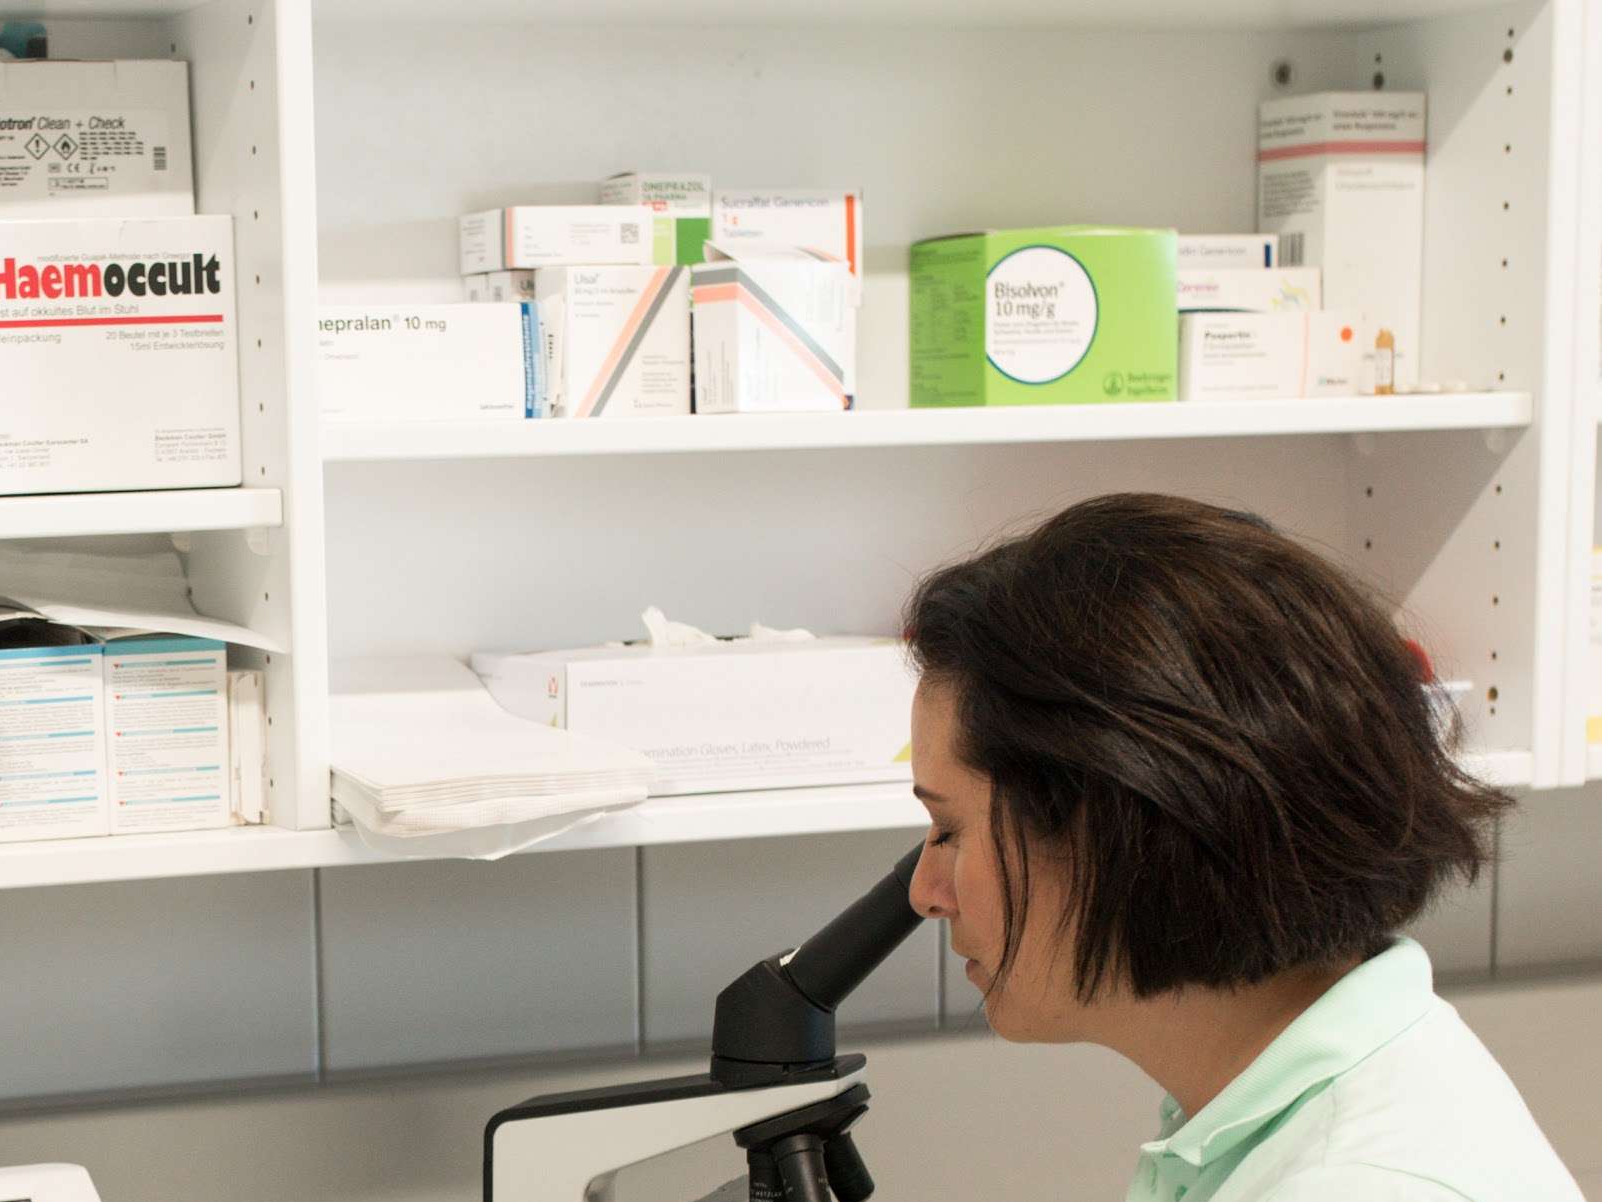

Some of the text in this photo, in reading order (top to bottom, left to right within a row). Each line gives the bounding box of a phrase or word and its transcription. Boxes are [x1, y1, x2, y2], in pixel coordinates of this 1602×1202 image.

[37, 117, 70, 130] Clean
[88, 116, 126, 130] Check
[994, 281, 1058, 299] Bisolvon
[12, 306, 29, 317] auf
[31, 305, 73, 317] okkultes
[76, 304, 97, 316] Blut
[100, 304, 112, 314] im
[114, 303, 140, 314] Stuhl
[995, 300, 1056, 319] 10 mg/g
[404, 317, 421, 330] 10
[425, 319, 447, 332] mg
